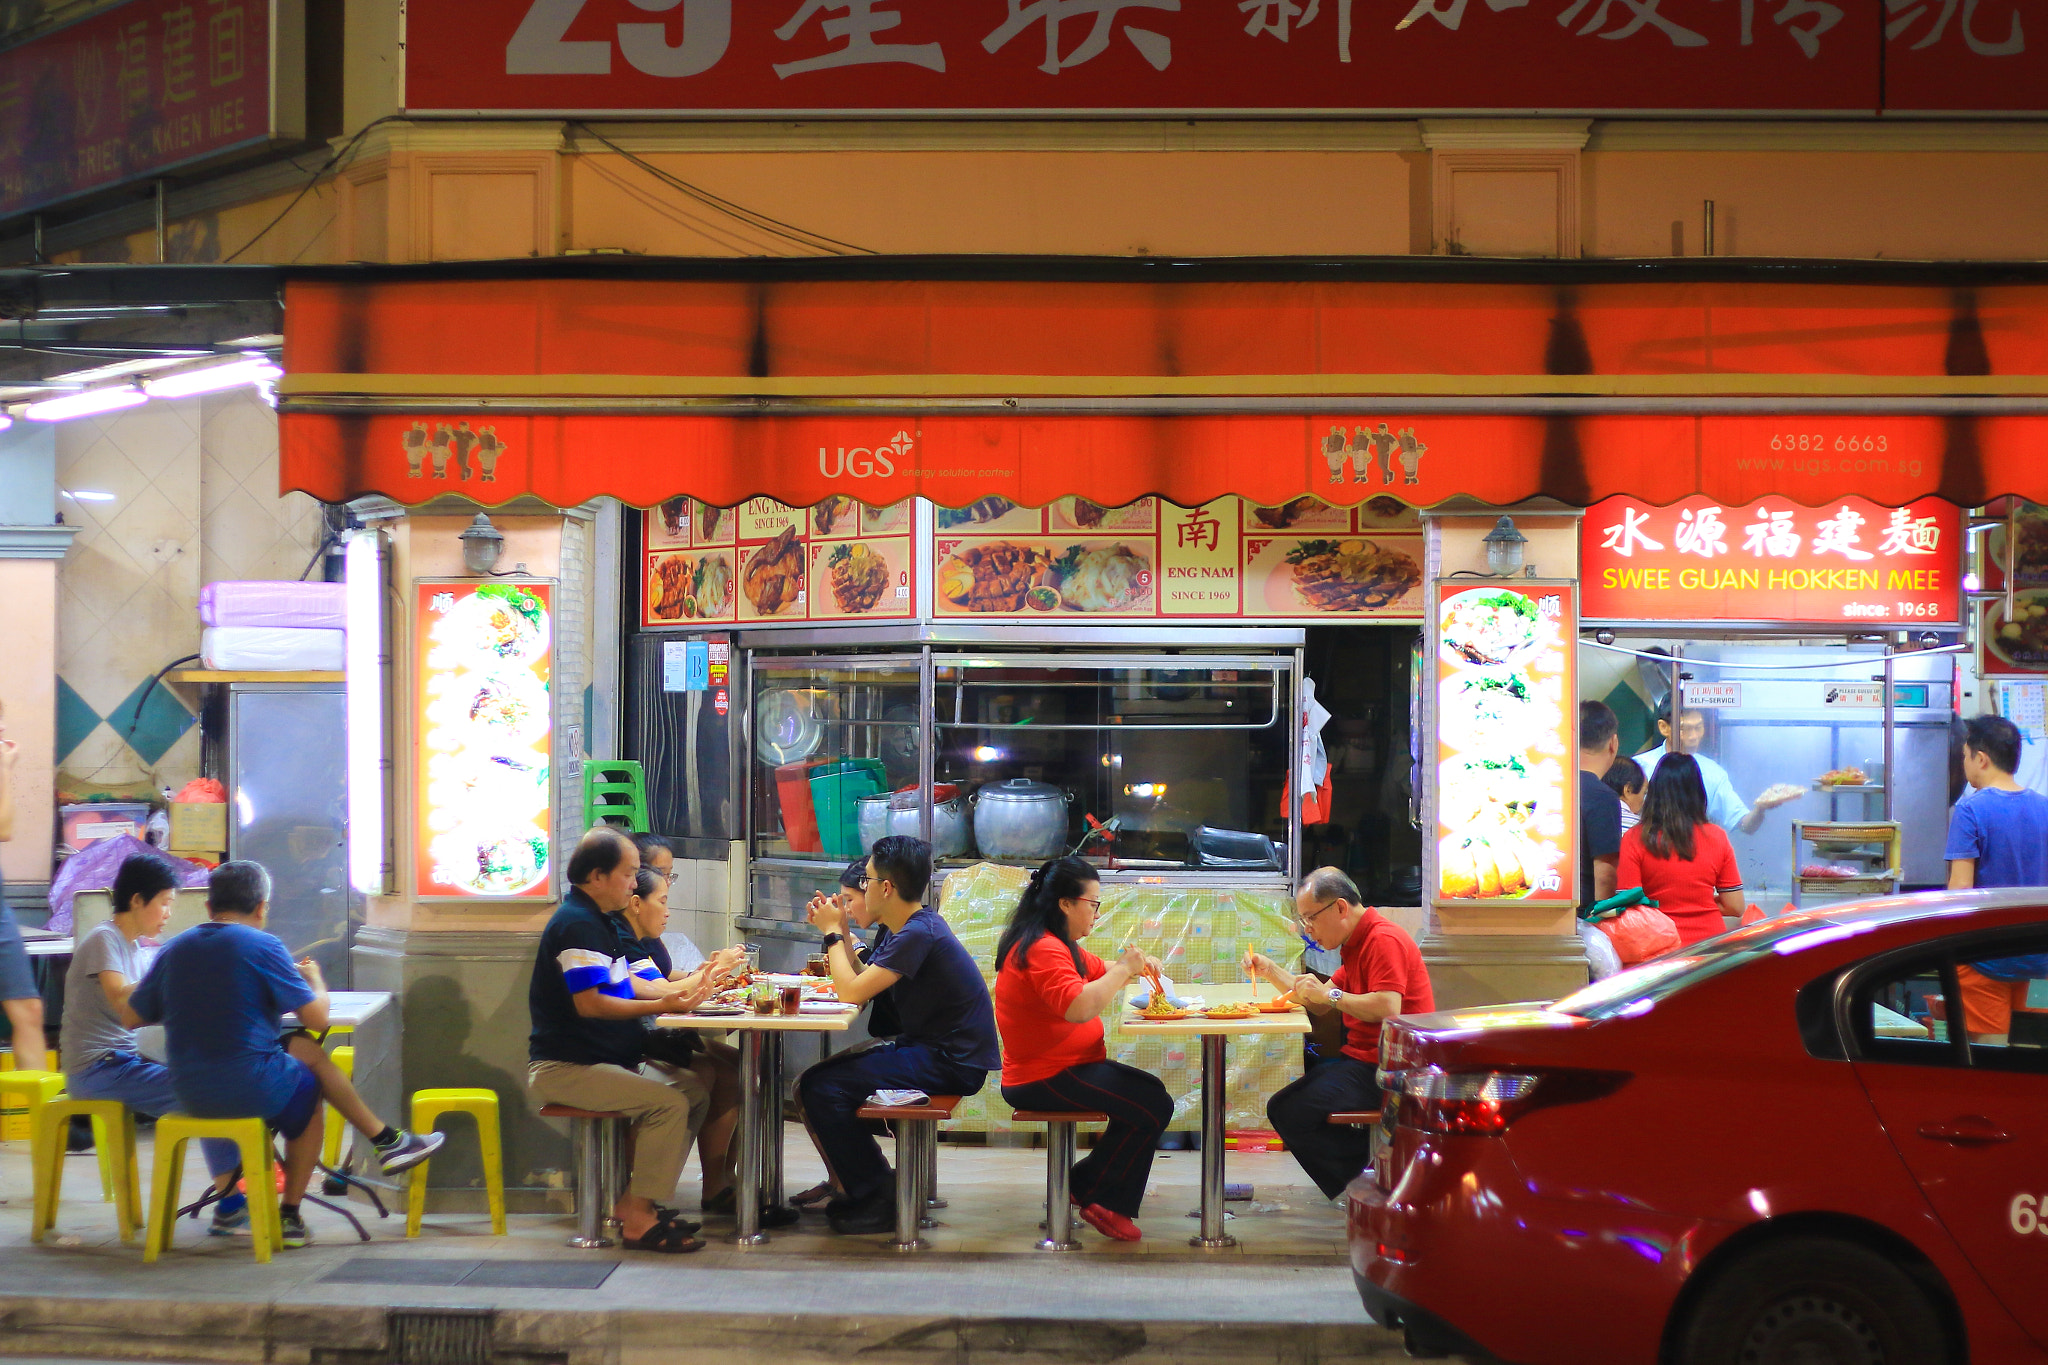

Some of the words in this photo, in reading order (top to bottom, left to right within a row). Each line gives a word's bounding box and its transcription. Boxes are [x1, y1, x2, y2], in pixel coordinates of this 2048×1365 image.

[209, 98, 246, 140] MEE
[1771, 434, 1824, 451] 6382
[1834, 435, 1888, 452] 6663
[819, 446, 895, 479] UGS
[1736, 457, 1922, 478] www.ugs.com.sg
[902, 468, 936, 480] energy
[938, 468, 975, 478] solution
[978, 468, 1015, 479] partner
[748, 498, 770, 515] ENG
[754, 518, 775, 530] SINCE
[1178, 508, 1221, 552] 南
[1167, 567, 1198, 578] ENG
[1201, 567, 1234, 578] NAM
[1602, 568, 1671, 590] SWEE
[1679, 568, 1760, 590] GUAN
[1768, 568, 1879, 590] HOKKEN
[1887, 569, 1940, 590] MEE
[1171, 590, 1206, 600] SINCE
[1208, 590, 1231, 600] 1969
[1843, 601, 1890, 617] since:
[1896, 601, 1939, 617] 1968
[693, 655, 702, 678] B
